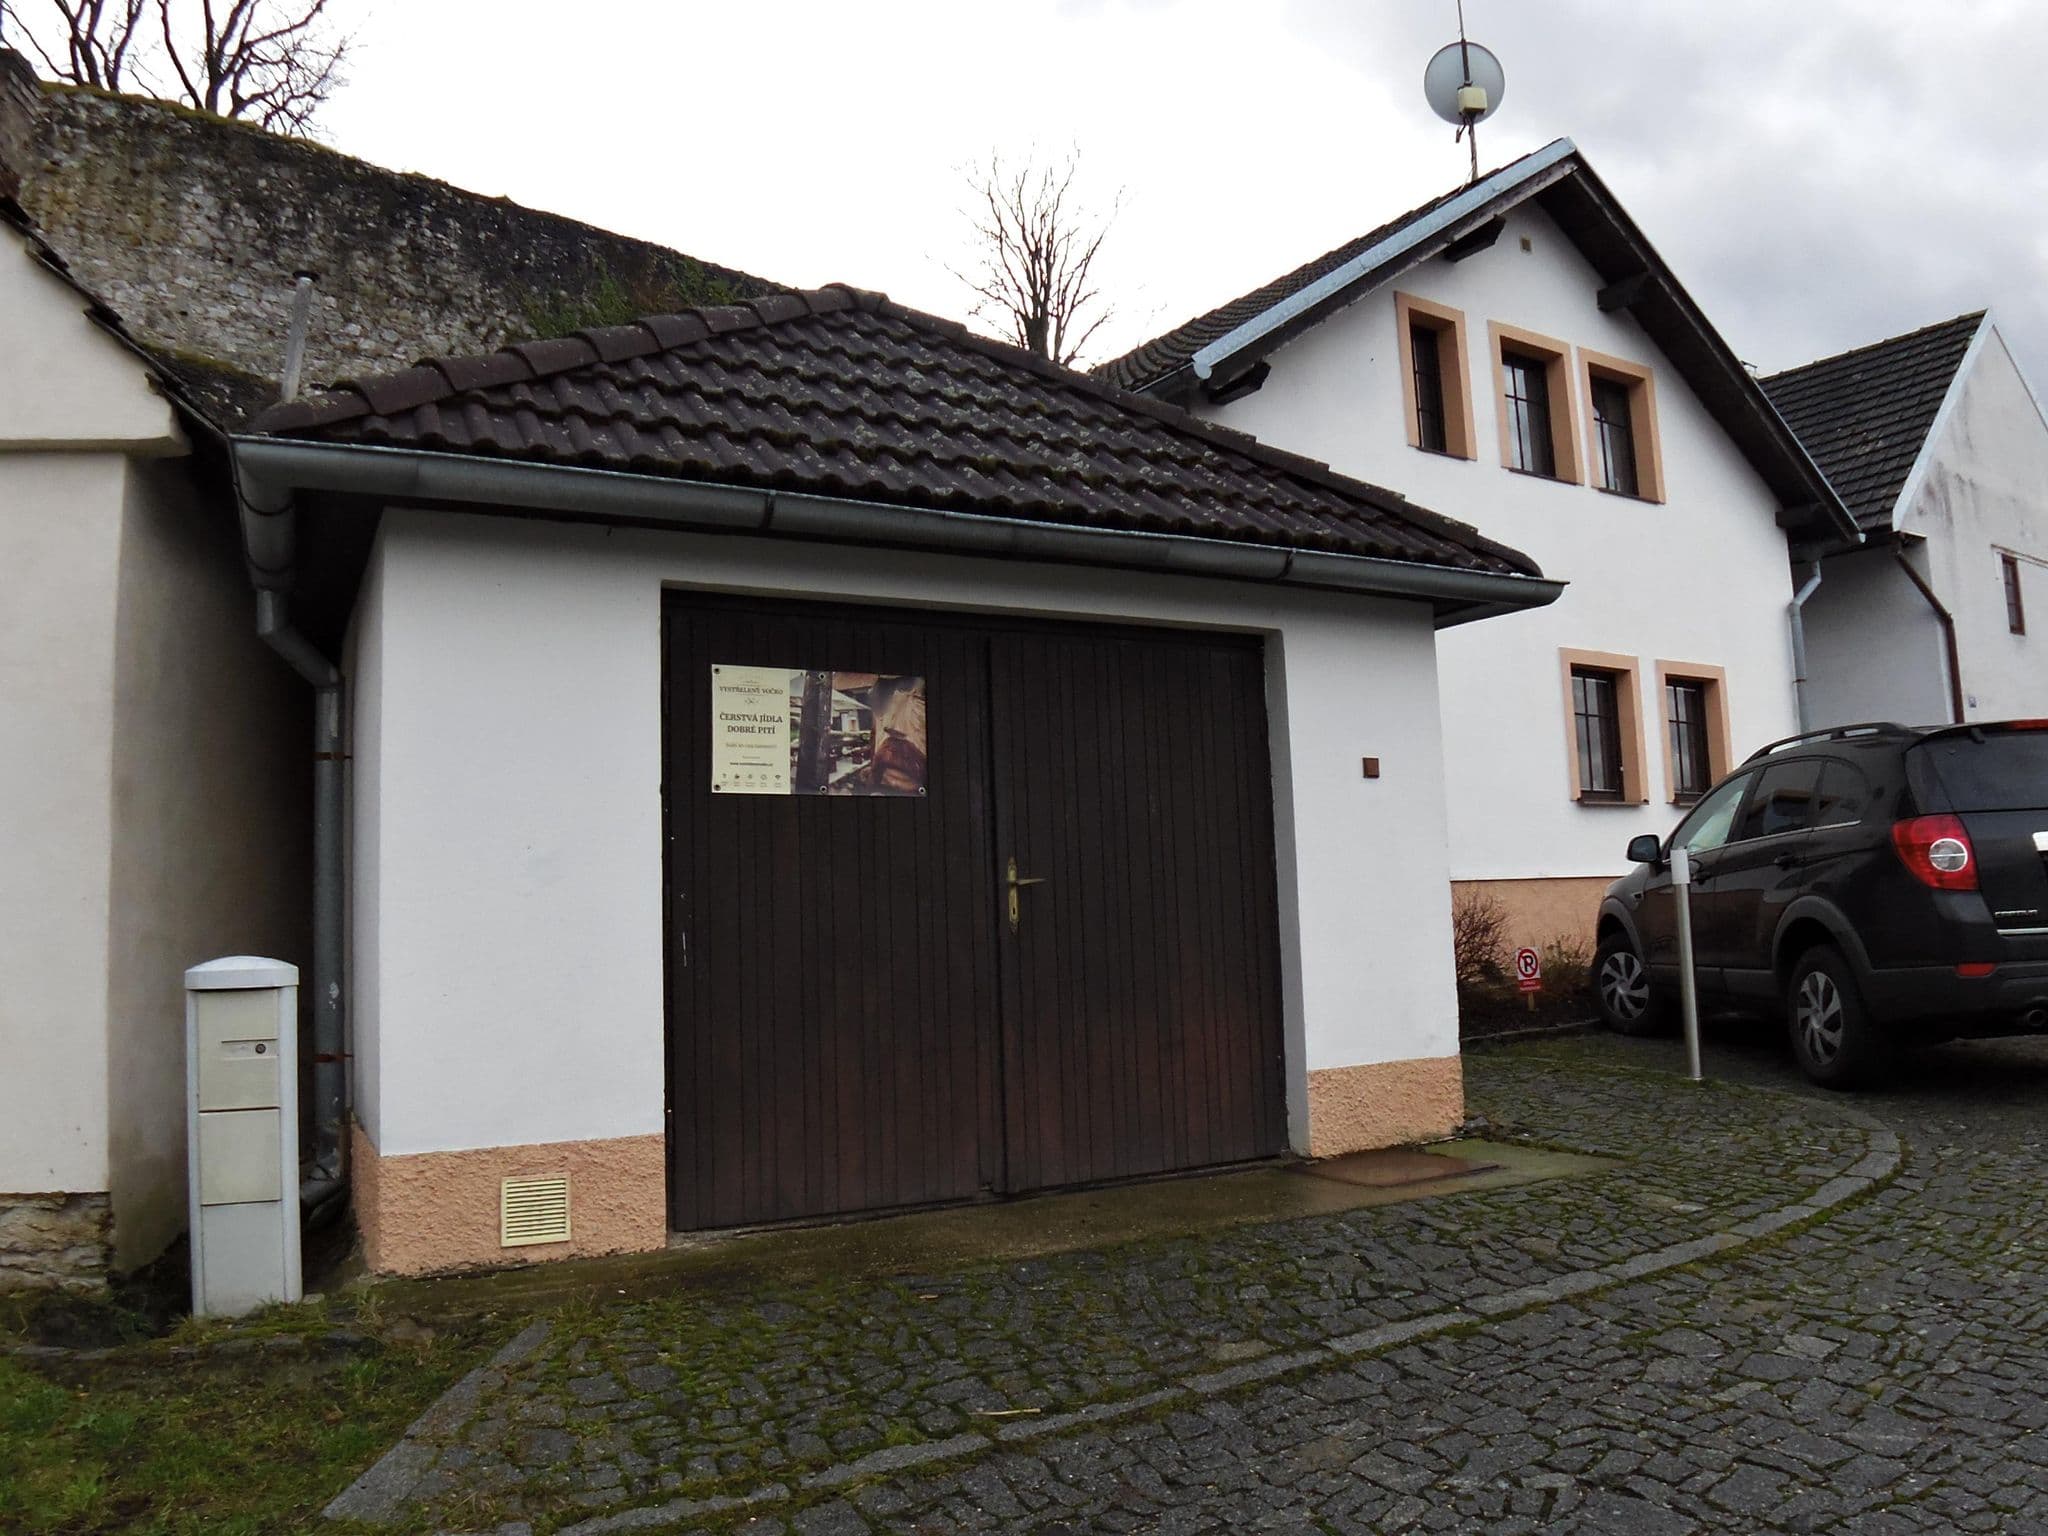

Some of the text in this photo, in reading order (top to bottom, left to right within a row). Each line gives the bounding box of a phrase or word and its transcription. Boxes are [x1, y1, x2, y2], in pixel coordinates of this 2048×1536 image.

[720, 712, 783, 723] ČERSTVÁ JÍDLA
[727, 724, 776, 734] DOBRÉ PITÍ
